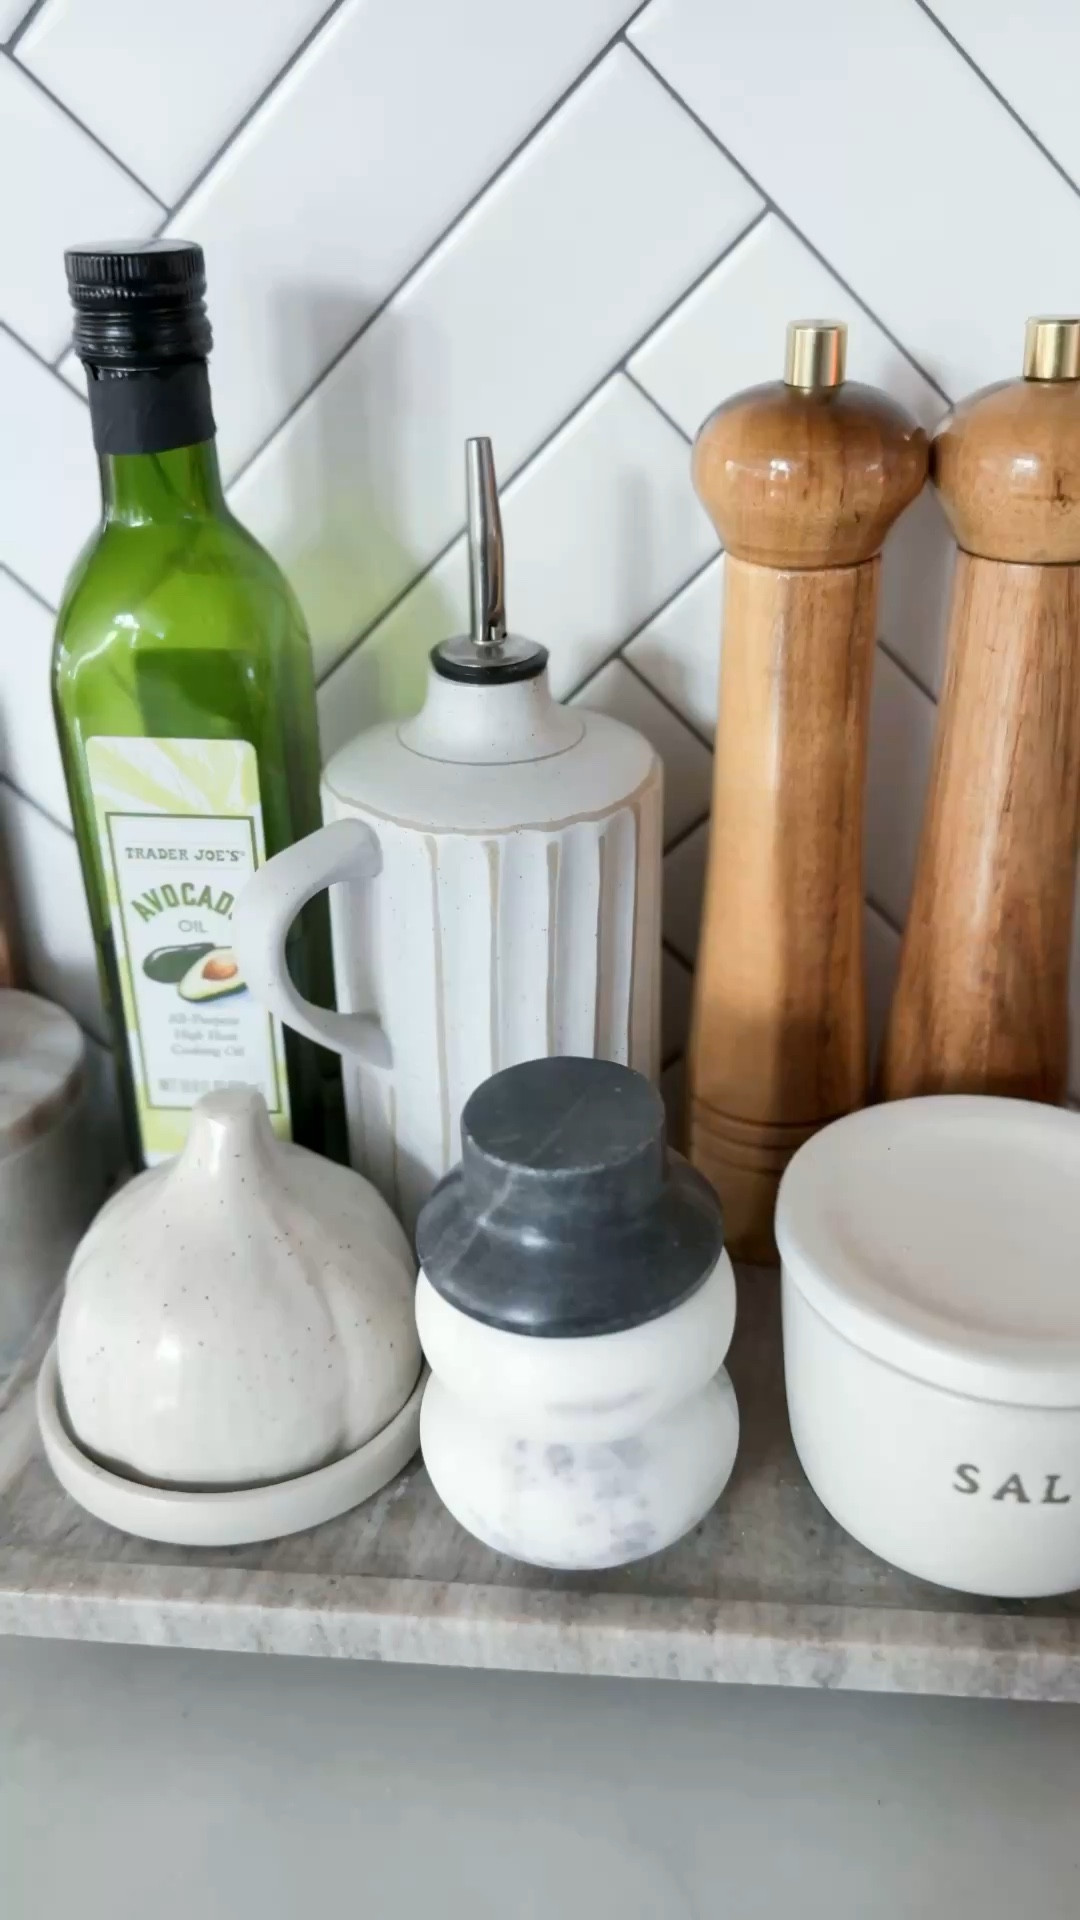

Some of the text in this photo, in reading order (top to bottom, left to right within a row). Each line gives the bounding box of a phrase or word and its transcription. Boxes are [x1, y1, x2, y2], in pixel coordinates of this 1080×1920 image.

[125, 847, 189, 861] TRADER
[131, 882, 235, 923] AVOCAD
[178, 919, 208, 933] OIL
[953, 1463, 1072, 1504] SAL
